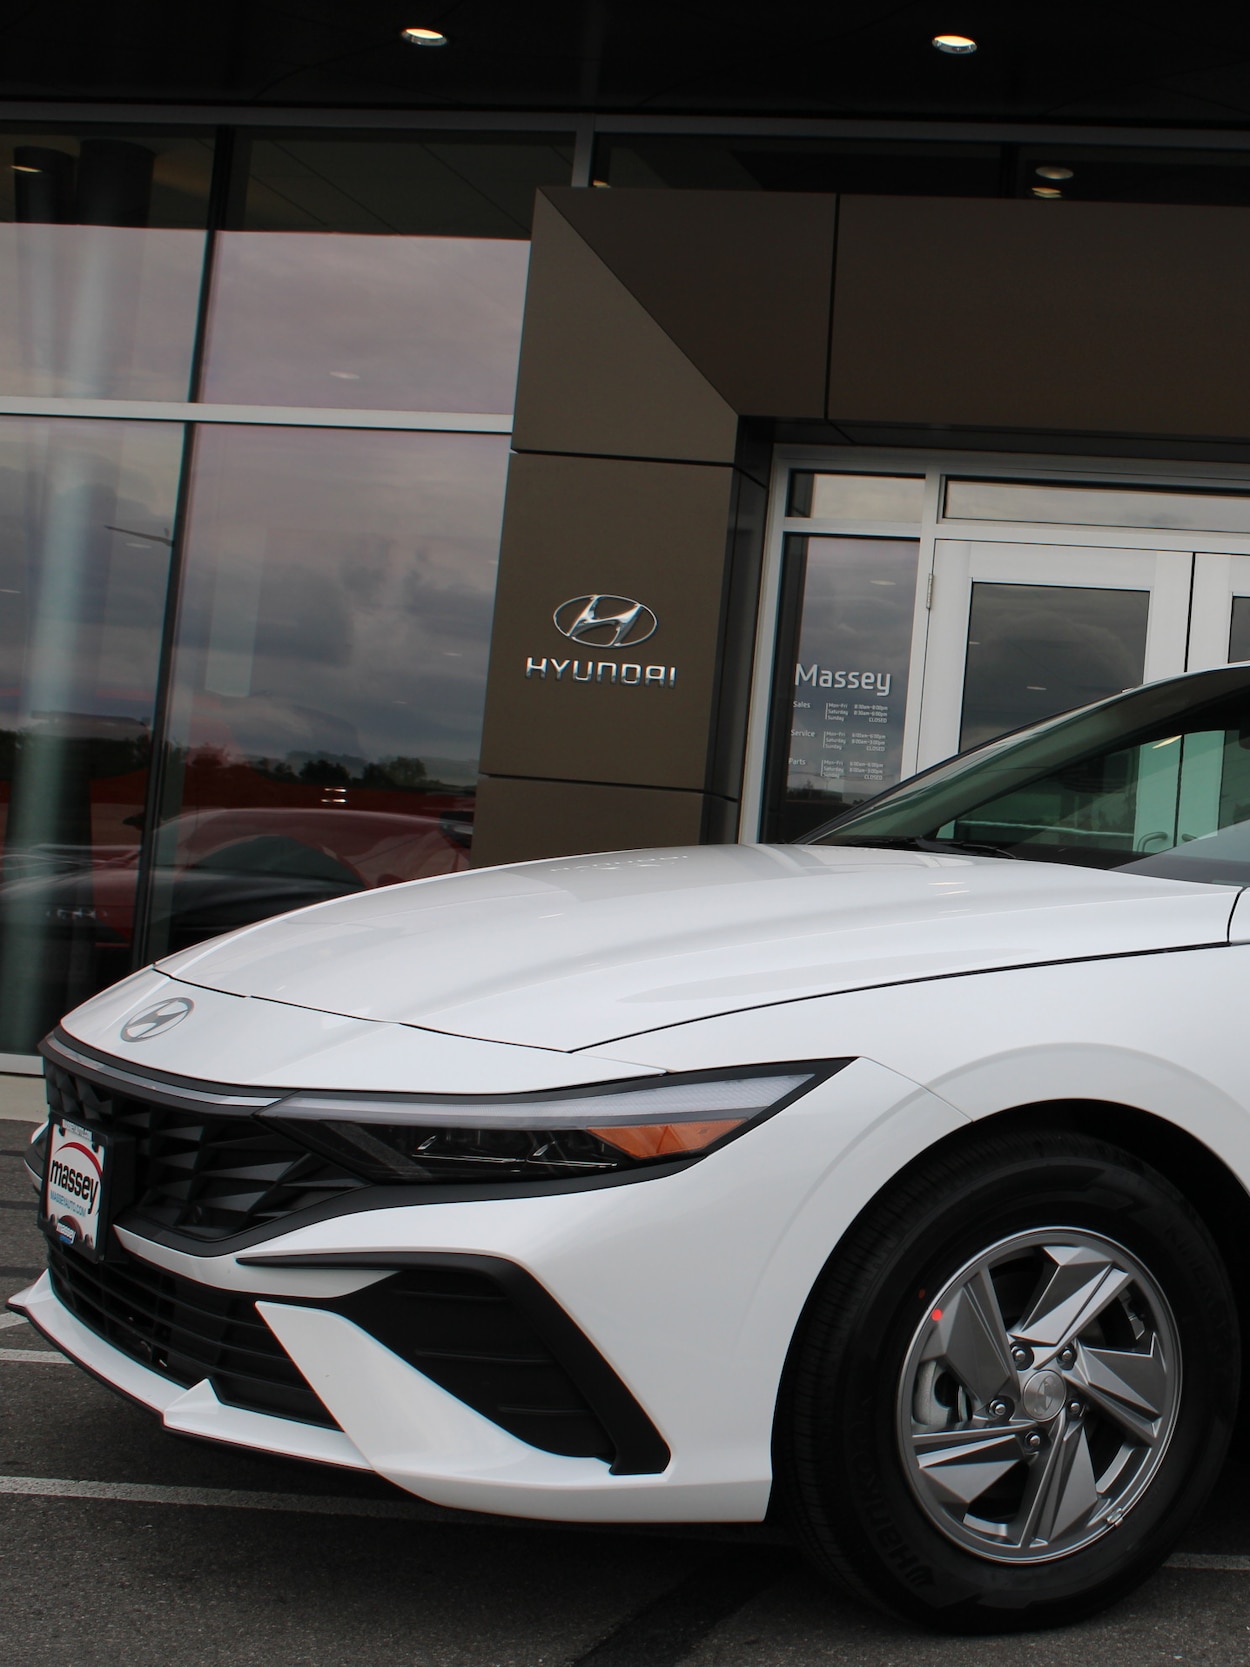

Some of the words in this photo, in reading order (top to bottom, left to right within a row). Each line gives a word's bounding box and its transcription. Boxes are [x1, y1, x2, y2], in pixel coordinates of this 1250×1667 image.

[525, 655, 677, 688] HYUNDAI
[794, 663, 891, 697] Massey
[790, 729, 816, 737] Service
[49, 1159, 100, 1215] massey
